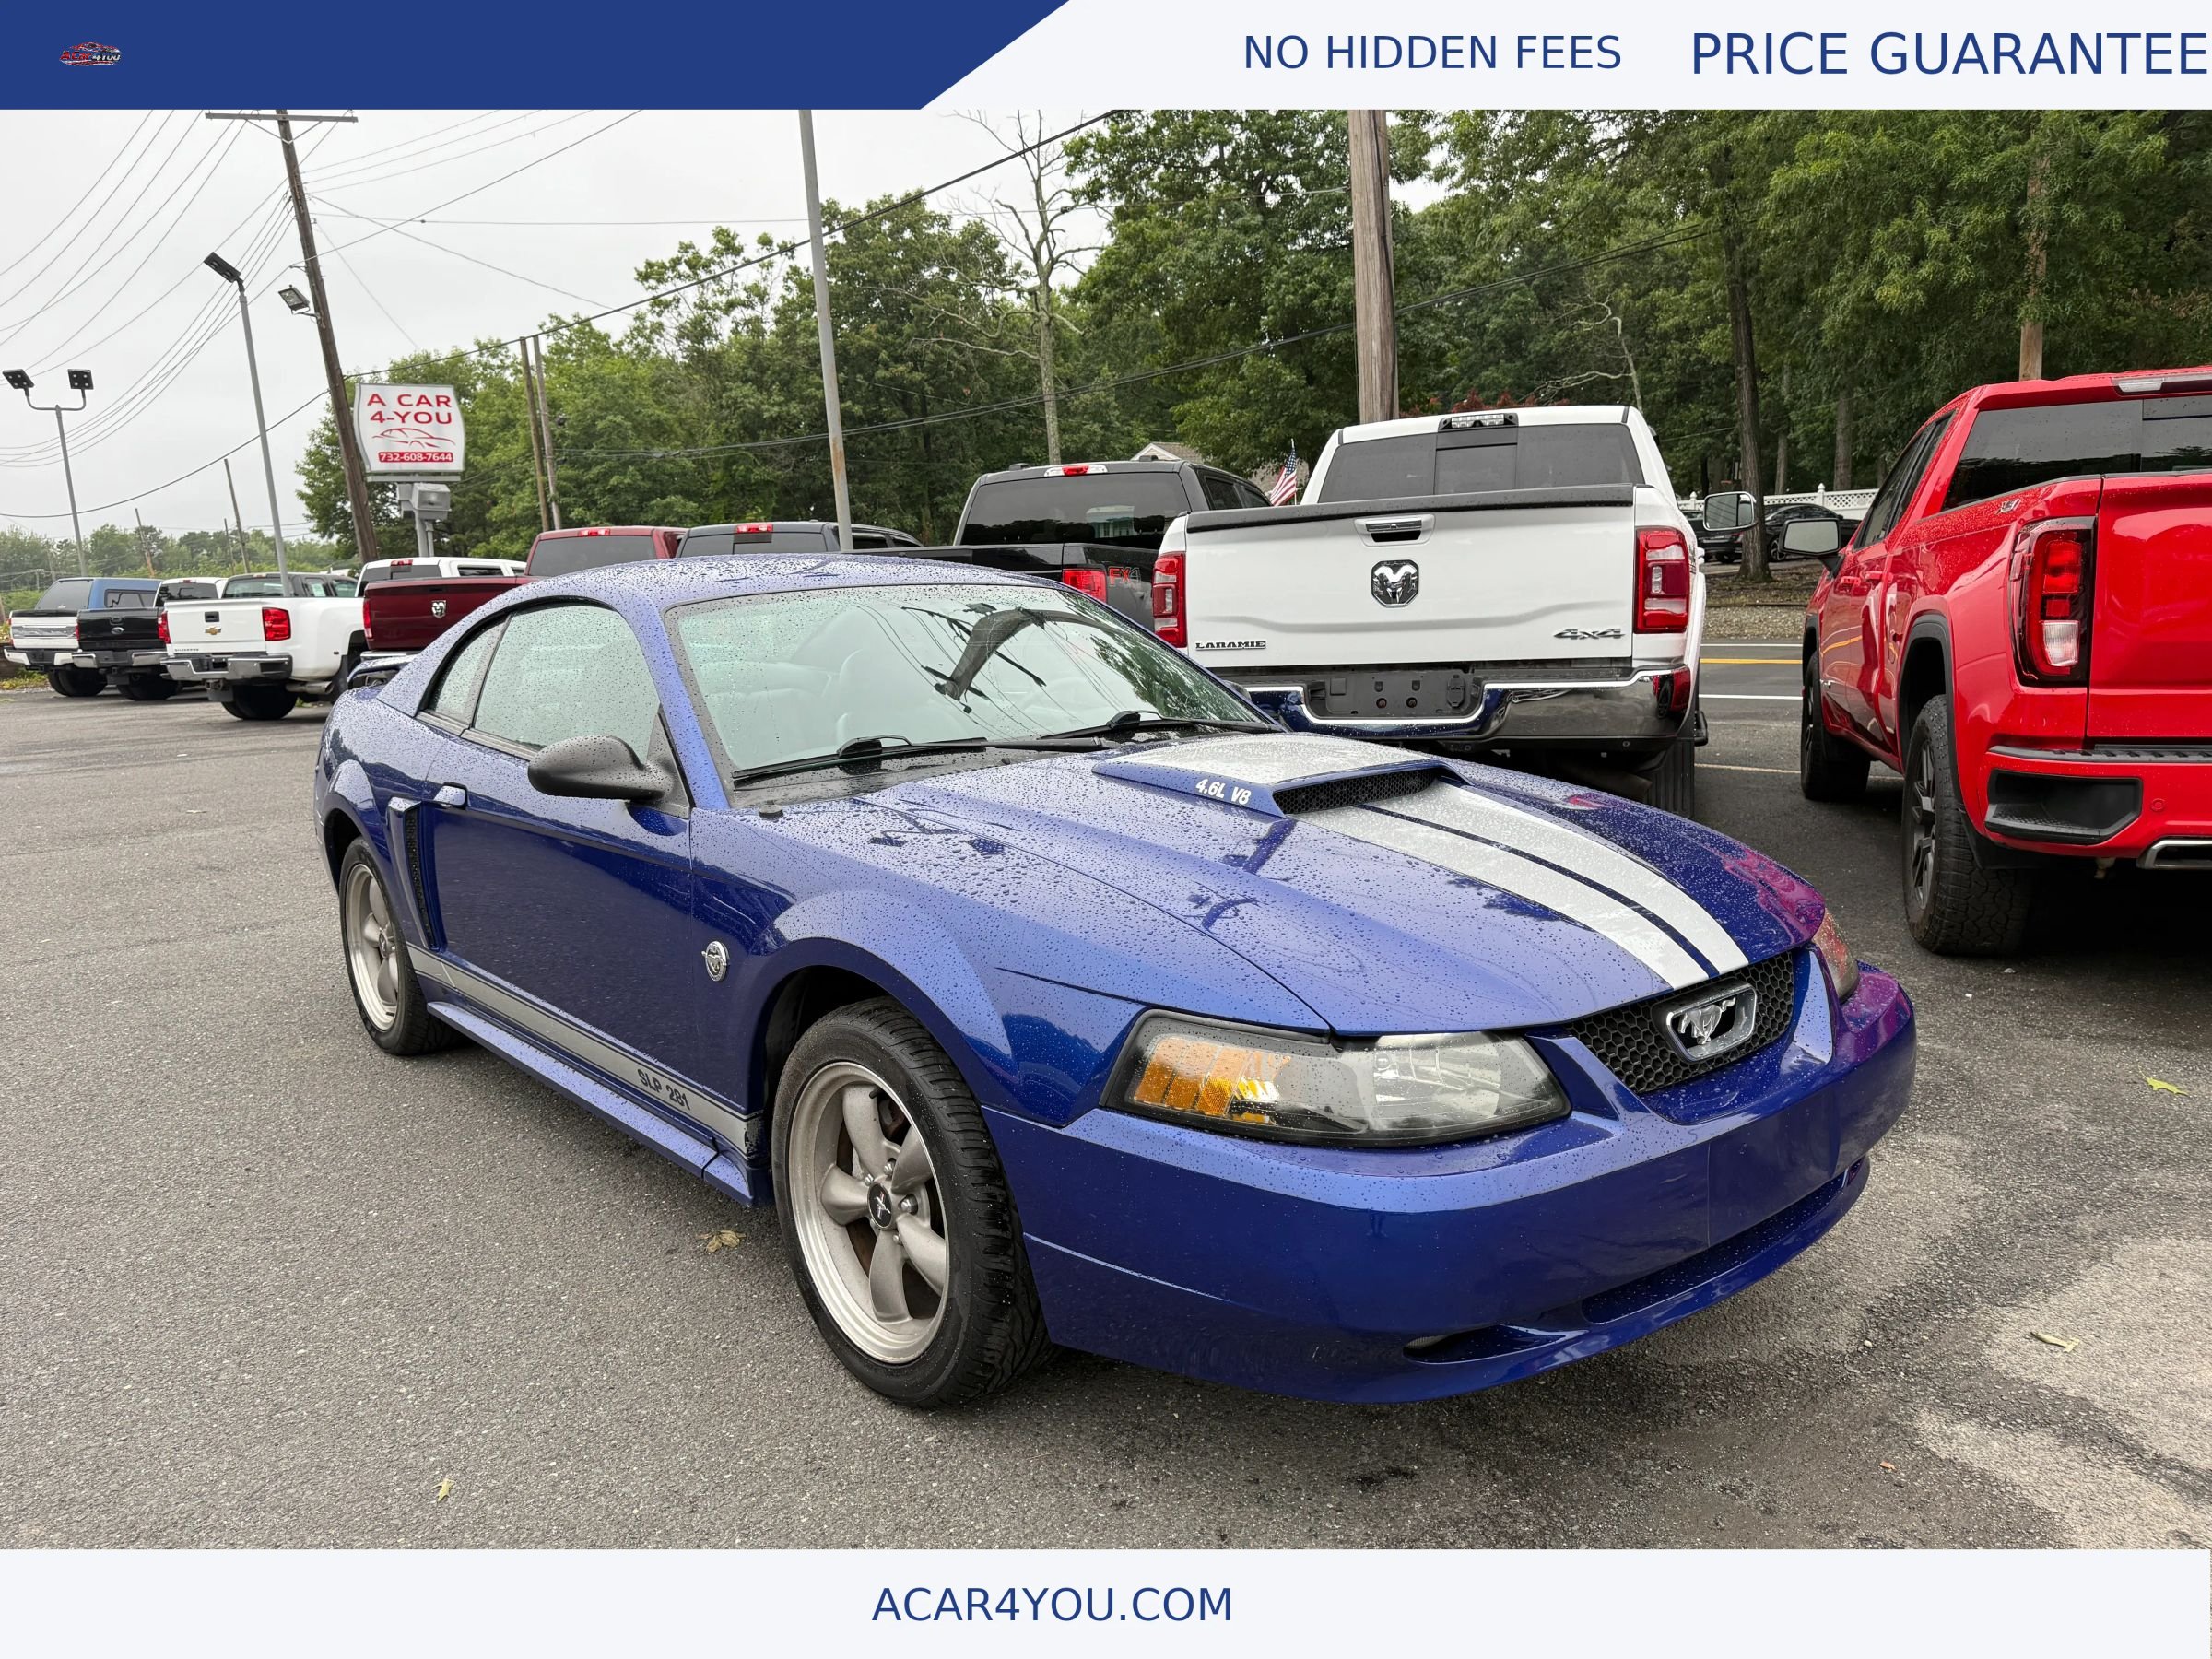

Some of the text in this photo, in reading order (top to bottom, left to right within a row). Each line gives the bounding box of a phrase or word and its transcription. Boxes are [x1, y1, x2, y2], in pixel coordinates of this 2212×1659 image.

[367, 394, 452, 407] A CAR
[370, 410, 453, 424] 4-YOU
[380, 453, 453, 462] 732-608-7644
[1108, 566, 1142, 587] FX4
[1195, 641, 1266, 650] LARAMIE
[1195, 778, 1252, 805] 4.6L V8
[637, 1068, 691, 1111] SLP 281
